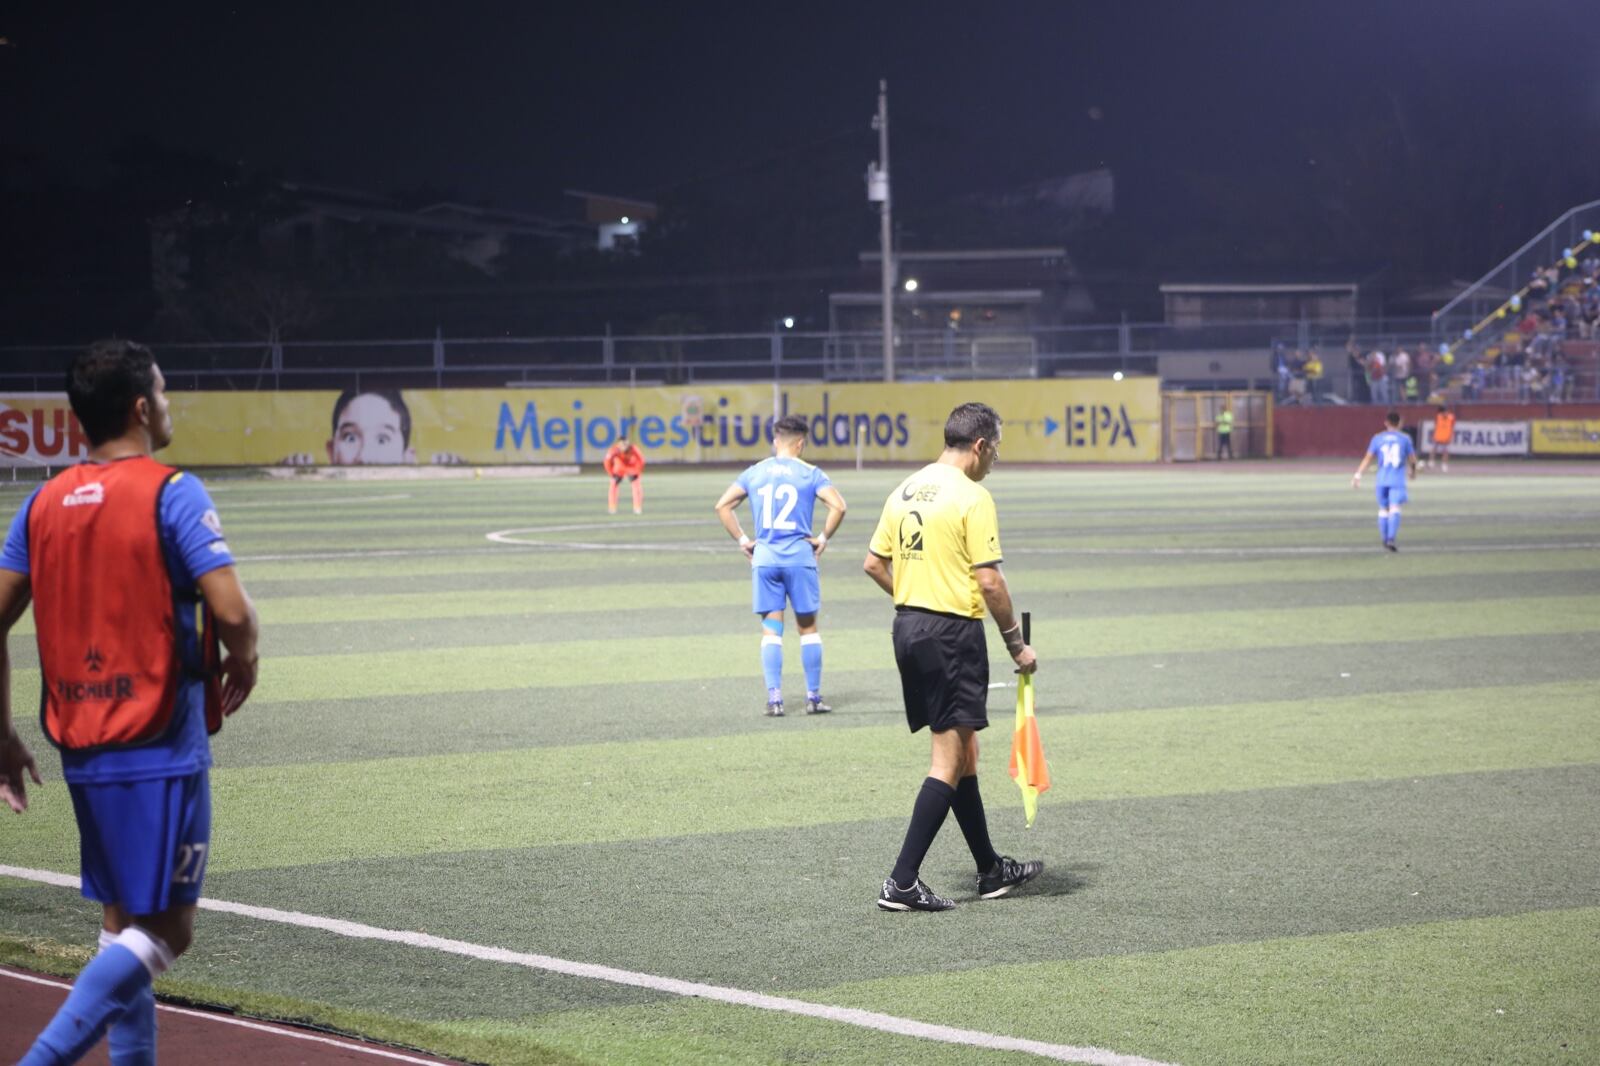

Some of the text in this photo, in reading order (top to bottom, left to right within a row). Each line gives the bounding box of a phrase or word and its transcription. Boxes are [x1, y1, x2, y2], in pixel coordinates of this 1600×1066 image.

[495, 400, 690, 464] Mejores
[1066, 404, 1136, 447] EPA
[1380, 443, 1400, 468] 14
[757, 483, 799, 530] 12
[172, 843, 208, 883] 27
